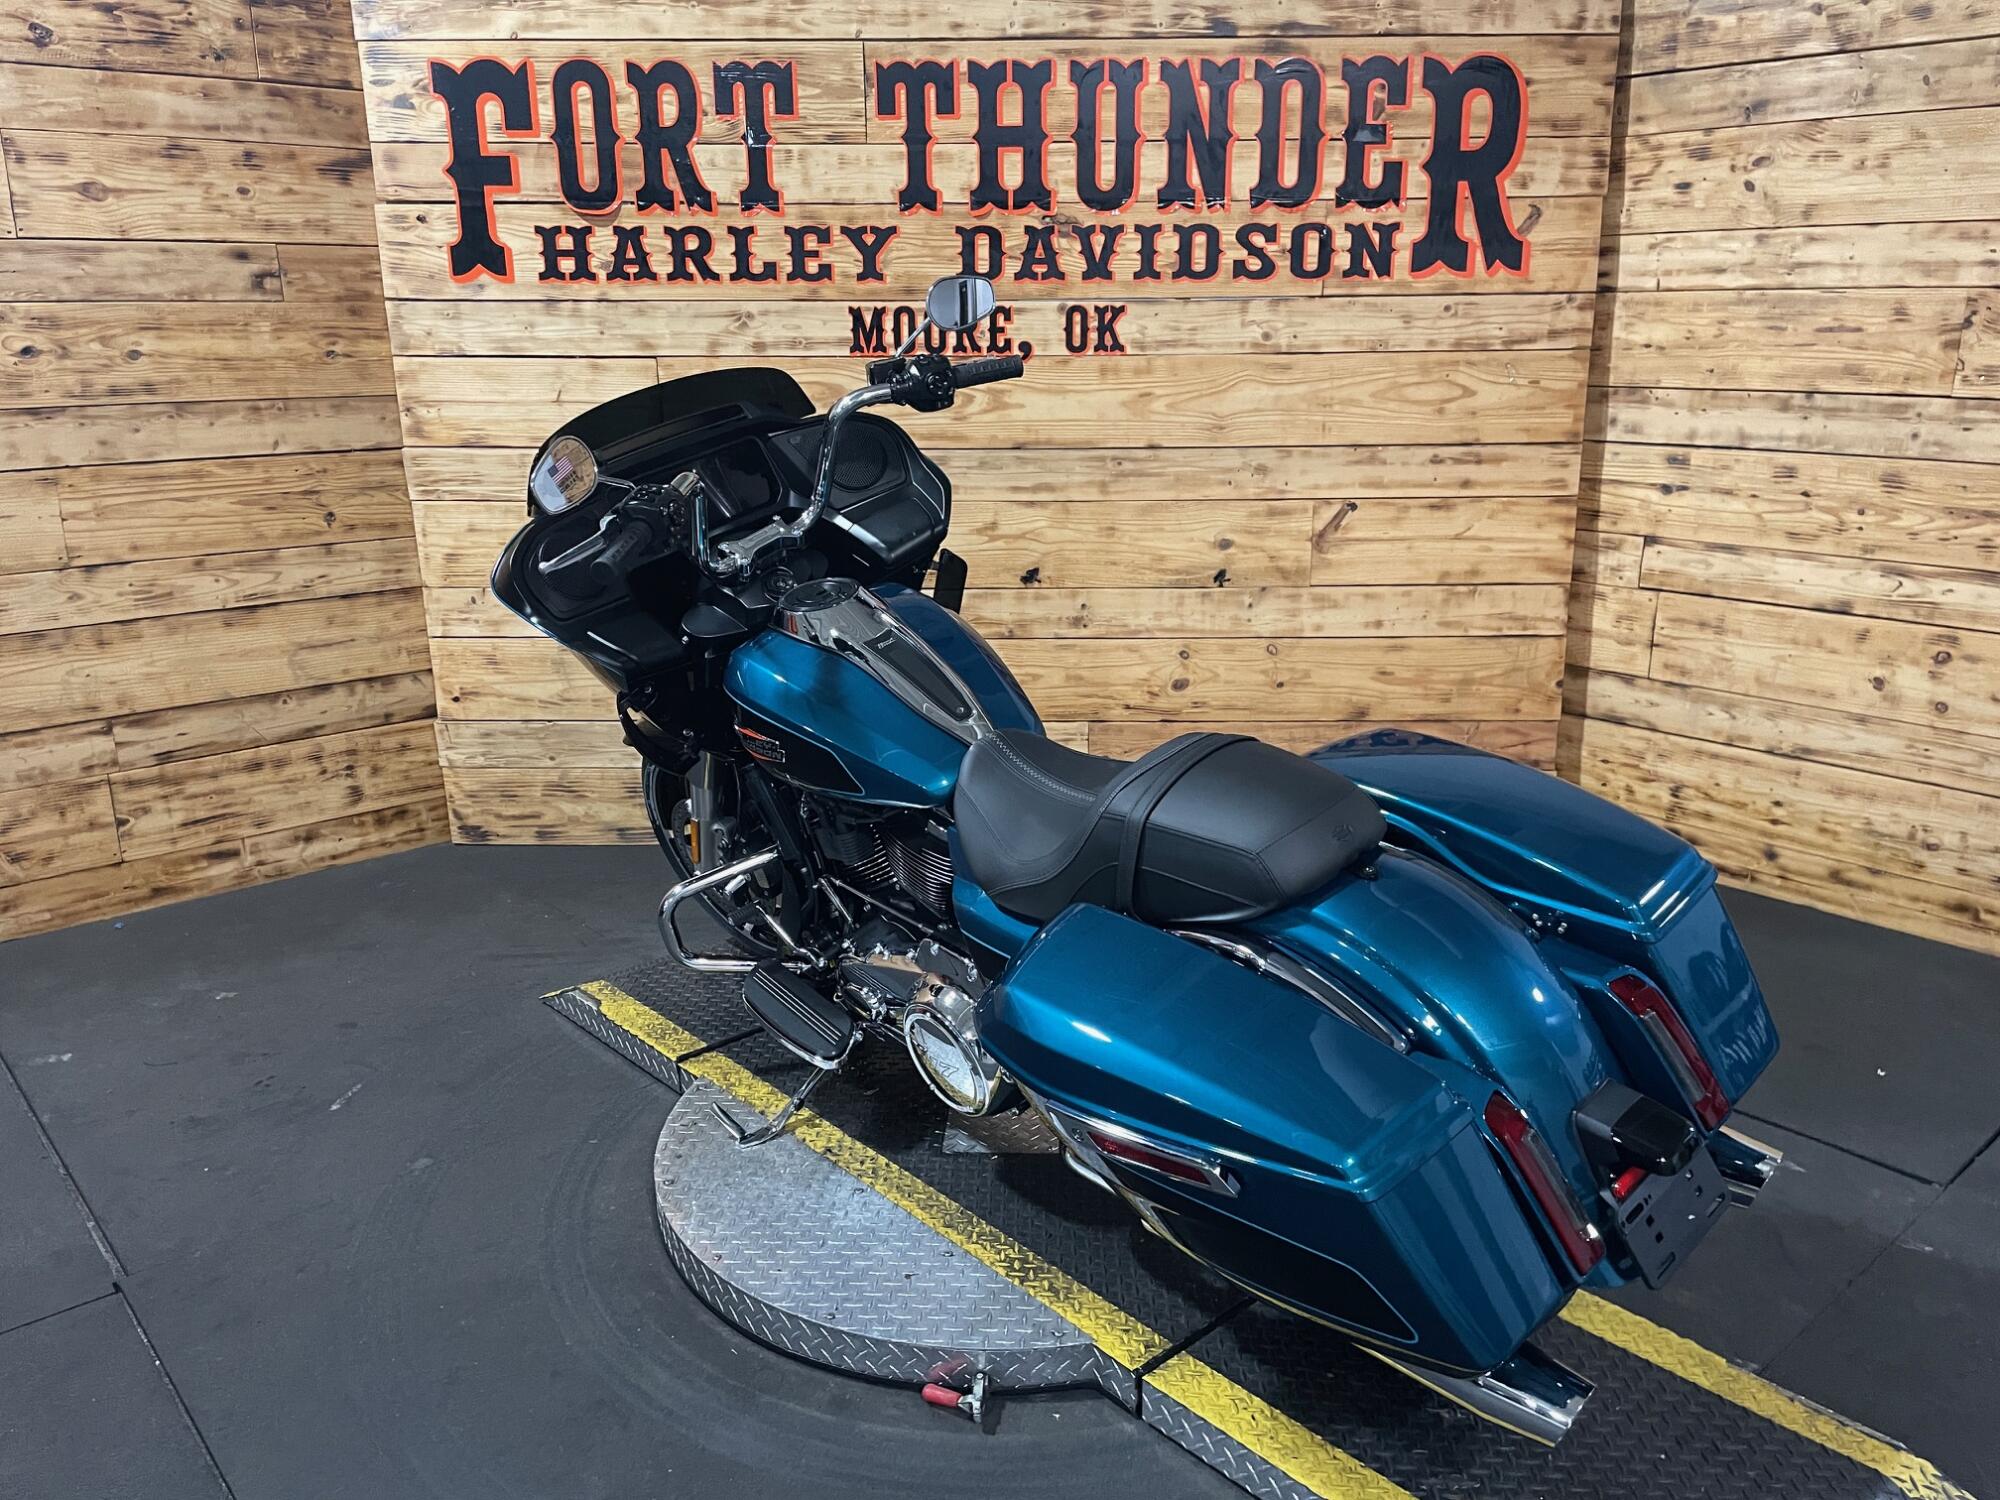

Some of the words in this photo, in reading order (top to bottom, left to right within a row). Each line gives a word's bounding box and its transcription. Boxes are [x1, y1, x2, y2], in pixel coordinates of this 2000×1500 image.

[428, 57, 799, 284] FORT
[874, 51, 1532, 279] THUNDER
[534, 225, 899, 284] HARLEY
[954, 221, 1404, 282] DAVIDSON
[1063, 304, 1127, 355] OK
